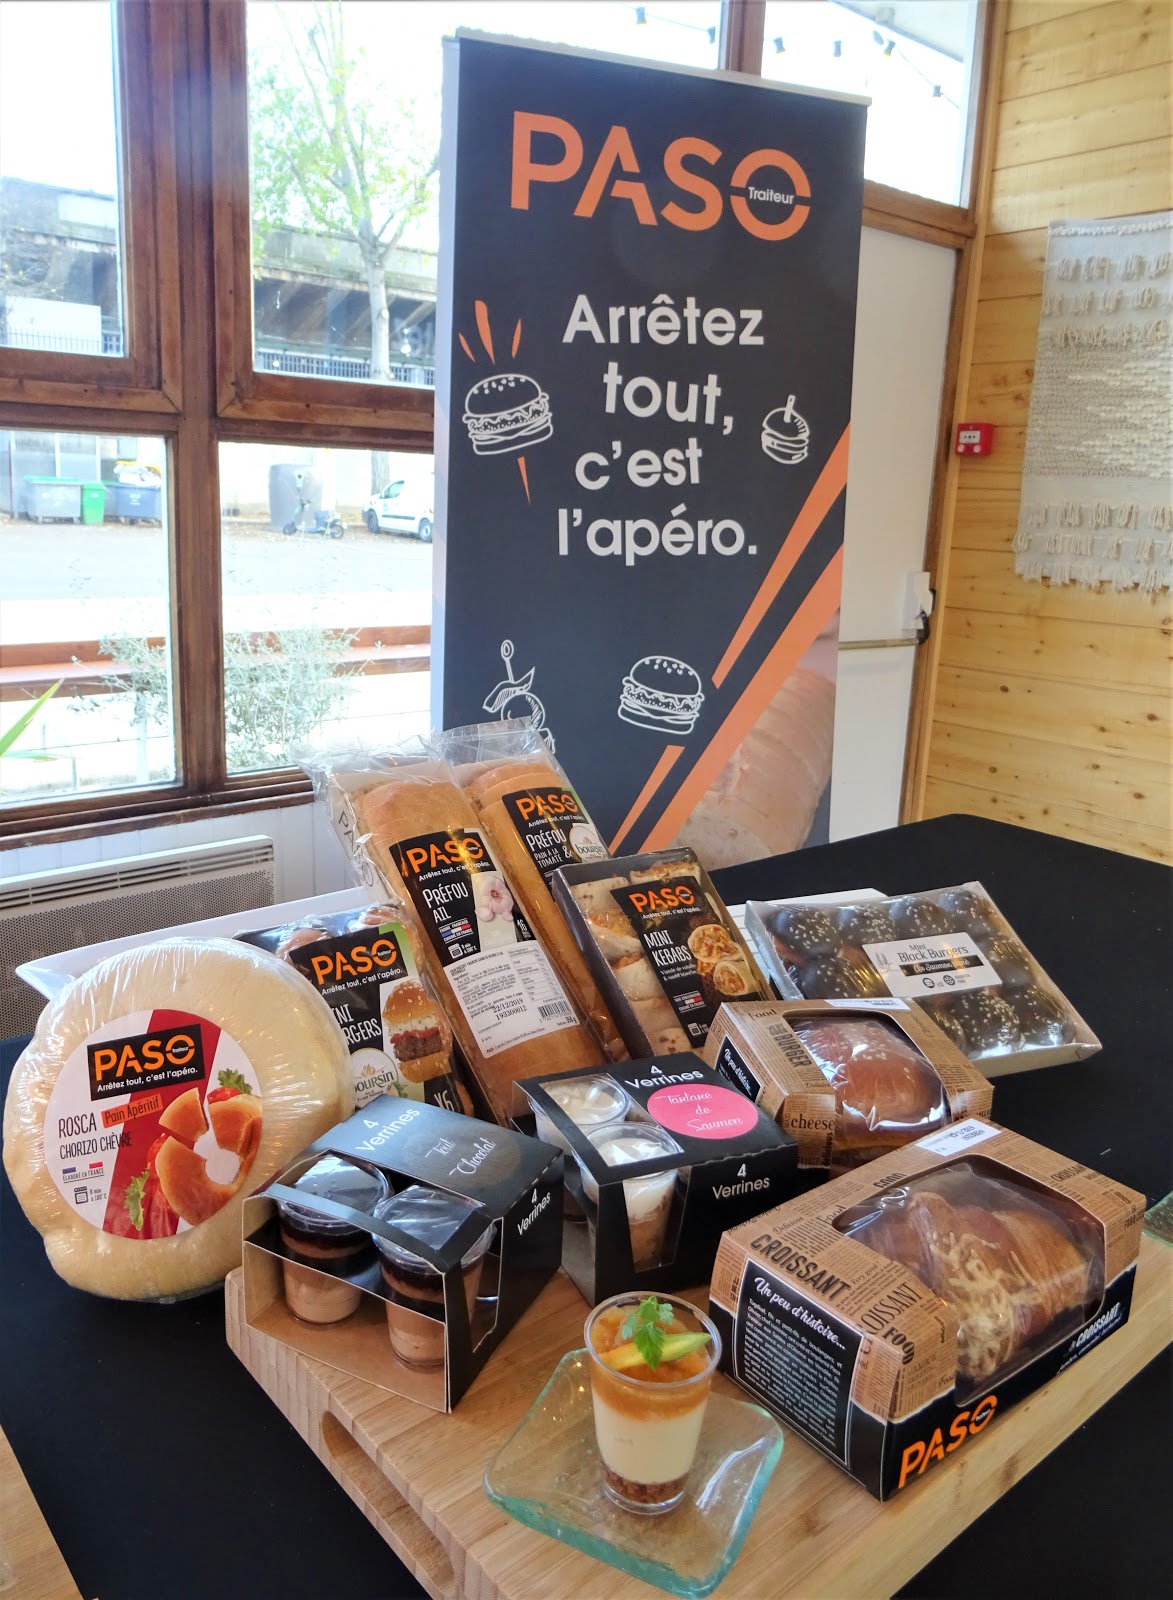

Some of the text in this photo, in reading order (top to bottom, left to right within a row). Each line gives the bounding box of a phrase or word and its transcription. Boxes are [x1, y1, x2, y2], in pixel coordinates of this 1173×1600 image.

[510, 111, 811, 241] PASO
[748, 186, 794, 204] Traiteur
[562, 294, 764, 345] Arrêtez
[603, 361, 733, 434] tout,
[575, 437, 702, 489] c'est
[558, 503, 757, 566] l'apéro.
[516, 794, 578, 820] PASO
[406, 838, 483, 873] PASO
[537, 854, 563, 868] TOMATE
[629, 886, 695, 913] PASO
[433, 906, 451, 923] AIL
[644, 929, 674, 949] MINI
[909, 943, 926, 951] Mini
[311, 940, 397, 985] PASO
[652, 945, 692, 967] KEBABS
[898, 946, 969, 962] Black Burgers
[322, 983, 346, 995] Arrêtez
[347, 978, 362, 988] tout,
[335, 1004, 354, 1027] INI
[344, 1017, 382, 1046] RGERS
[94, 1035, 195, 1081] PASO
[774, 1033, 813, 1067] BURGER
[97, 1067, 198, 1092] Arrêtez tout, c'est l'apéro.
[625, 1069, 704, 1089] Verrines
[650, 1065, 662, 1074] 4
[104, 1097, 160, 1125] Pain Apéritif
[654, 1091, 712, 1105] Tartare
[695, 1104, 711, 1115] de
[59, 1112, 97, 1139] ROSCA
[355, 1107, 421, 1152] Verrines
[363, 1119, 380, 1129] 4
[687, 1117, 743, 1132] Saumon
[791, 1113, 835, 1130] cheese
[60, 1131, 132, 1160] CHORIZO CHÈVRE
[449, 1137, 497, 1176] Chocolat
[737, 1163, 747, 1177] 4
[531, 1188, 538, 1203] 4
[712, 1176, 770, 1200] Verrines
[517, 1191, 551, 1236] Verrines
[750, 1233, 850, 1299] CROISSANT
[755, 1277, 772, 1297] Un
[770, 1293, 792, 1310] peu
[881, 1326, 915, 1365] FOOD
[899, 1395, 997, 1489] PASO
